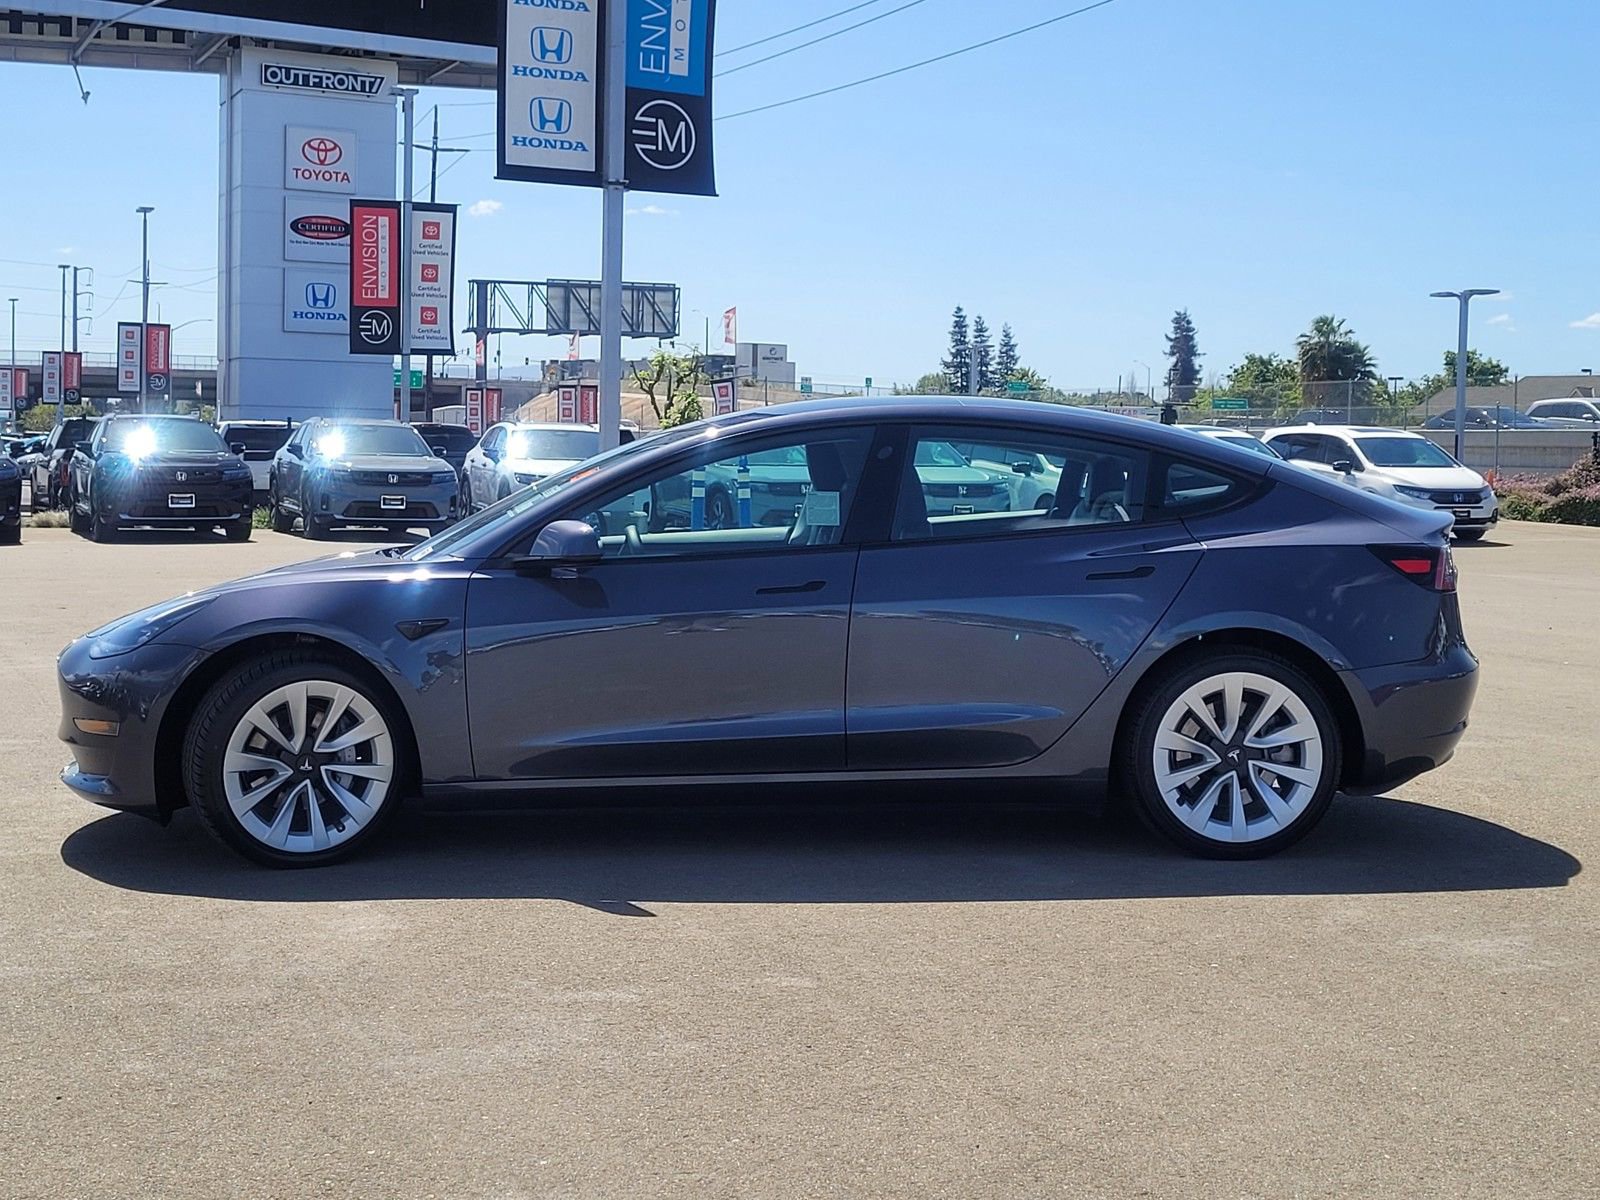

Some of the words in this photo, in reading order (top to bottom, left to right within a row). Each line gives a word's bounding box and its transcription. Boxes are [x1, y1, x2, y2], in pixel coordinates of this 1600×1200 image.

[512, 65, 589, 82] HONDA
[511, 136, 589, 152] HONDA
[292, 167, 351, 184] TOYOTA
[418, 242, 443, 250] Certified
[362, 215, 377, 299] ENVISION
[292, 310, 348, 321] HONDA
[417, 327, 441, 335] Certified
